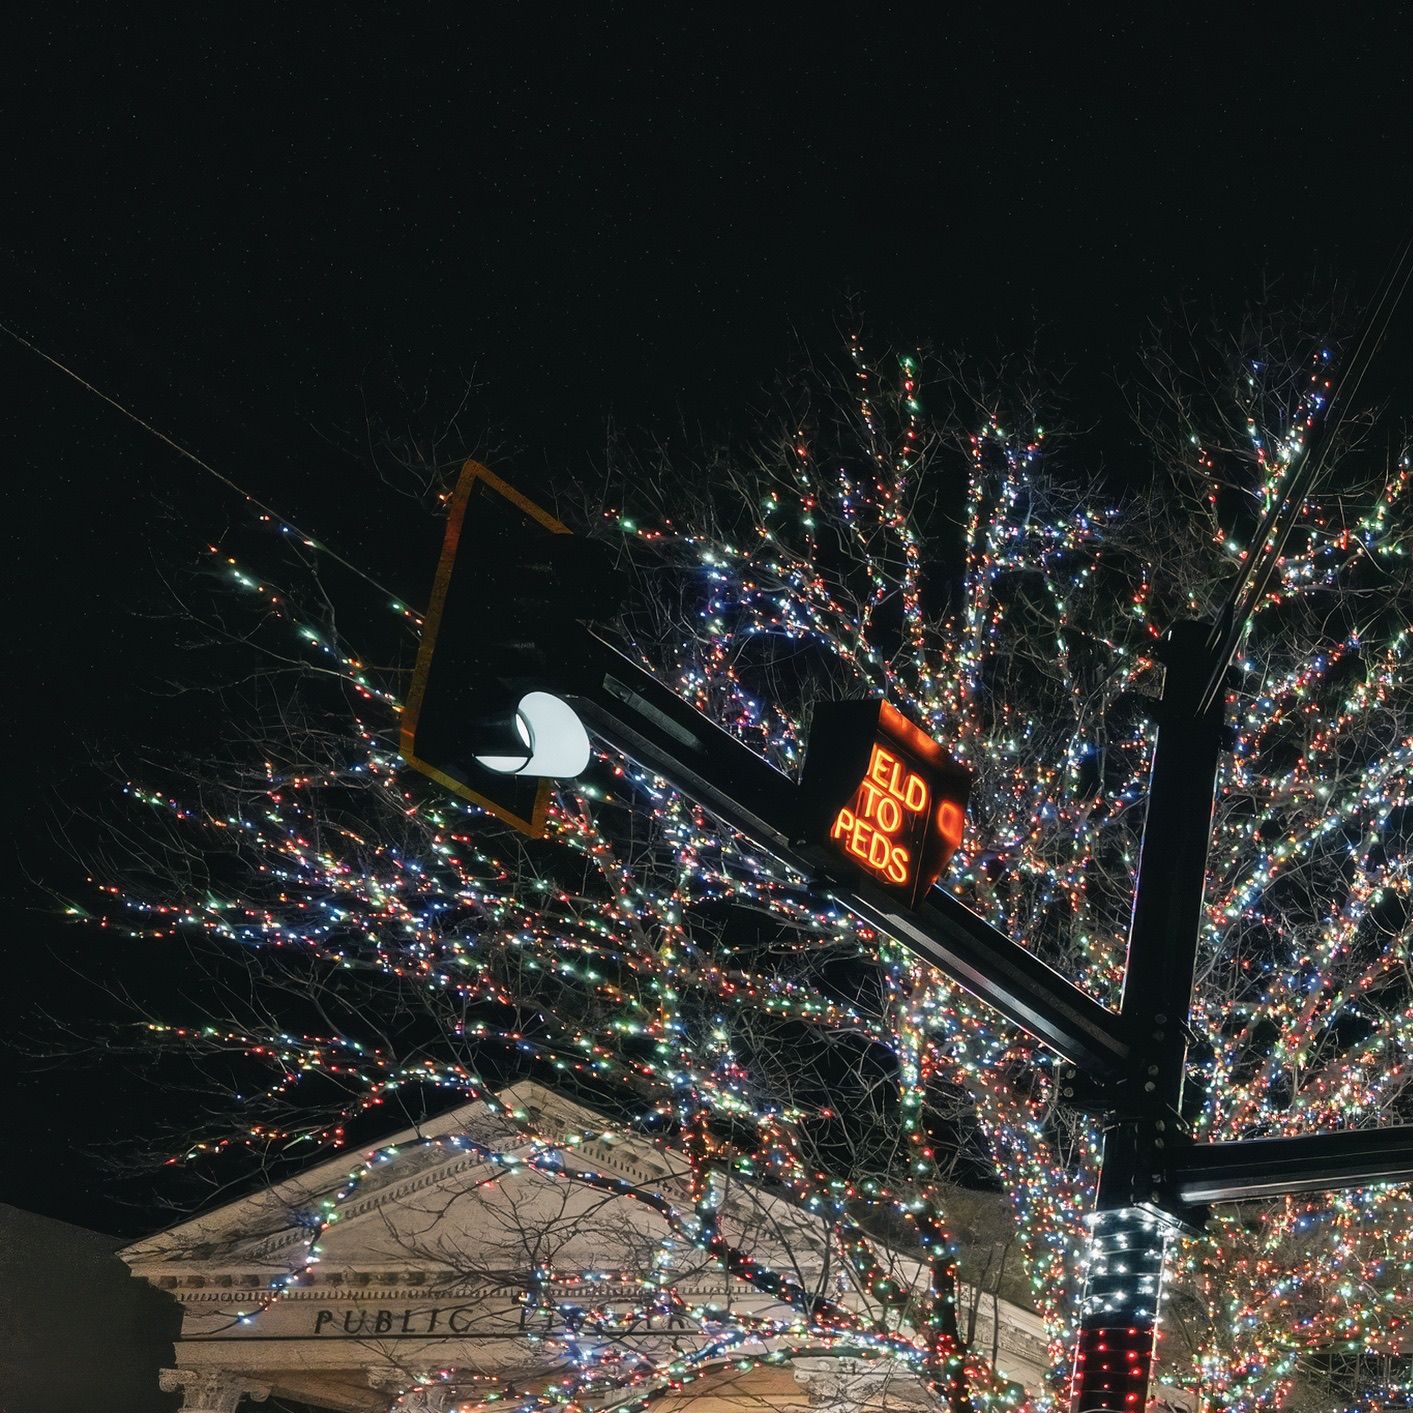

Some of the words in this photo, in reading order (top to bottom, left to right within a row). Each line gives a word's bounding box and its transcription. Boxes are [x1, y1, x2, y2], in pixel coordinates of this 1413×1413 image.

[863, 781, 899, 832] TO
[834, 808, 909, 883] PEDS
[314, 1309, 472, 1334] PUBLIC
